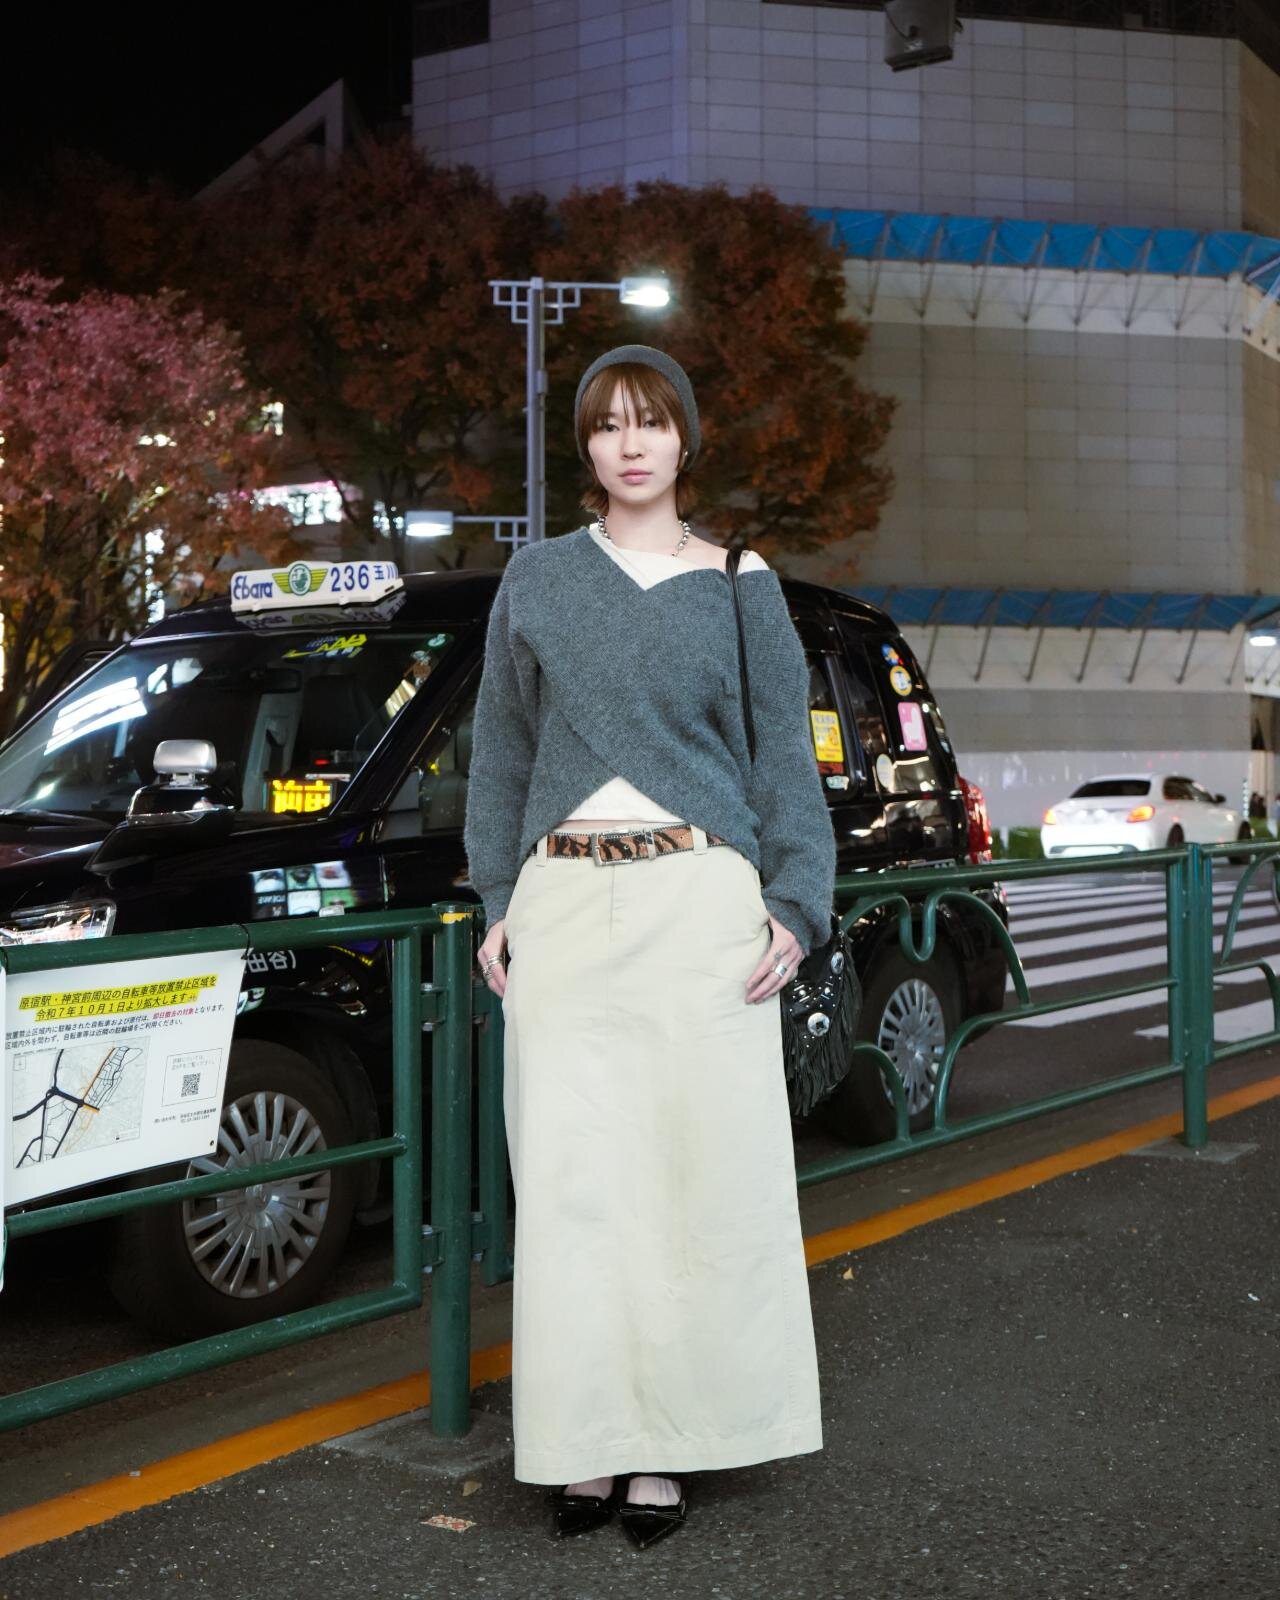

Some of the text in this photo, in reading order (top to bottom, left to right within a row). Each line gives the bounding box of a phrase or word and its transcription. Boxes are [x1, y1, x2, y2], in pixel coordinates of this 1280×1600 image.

[233, 575, 273, 600] Ebara
[331, 564, 369, 592] 236
[245, 949, 297, 974] 田谷)
[19, 975, 217, 1009] 原宿駅・神宮前周辺の自転車等放置禁止区域を
